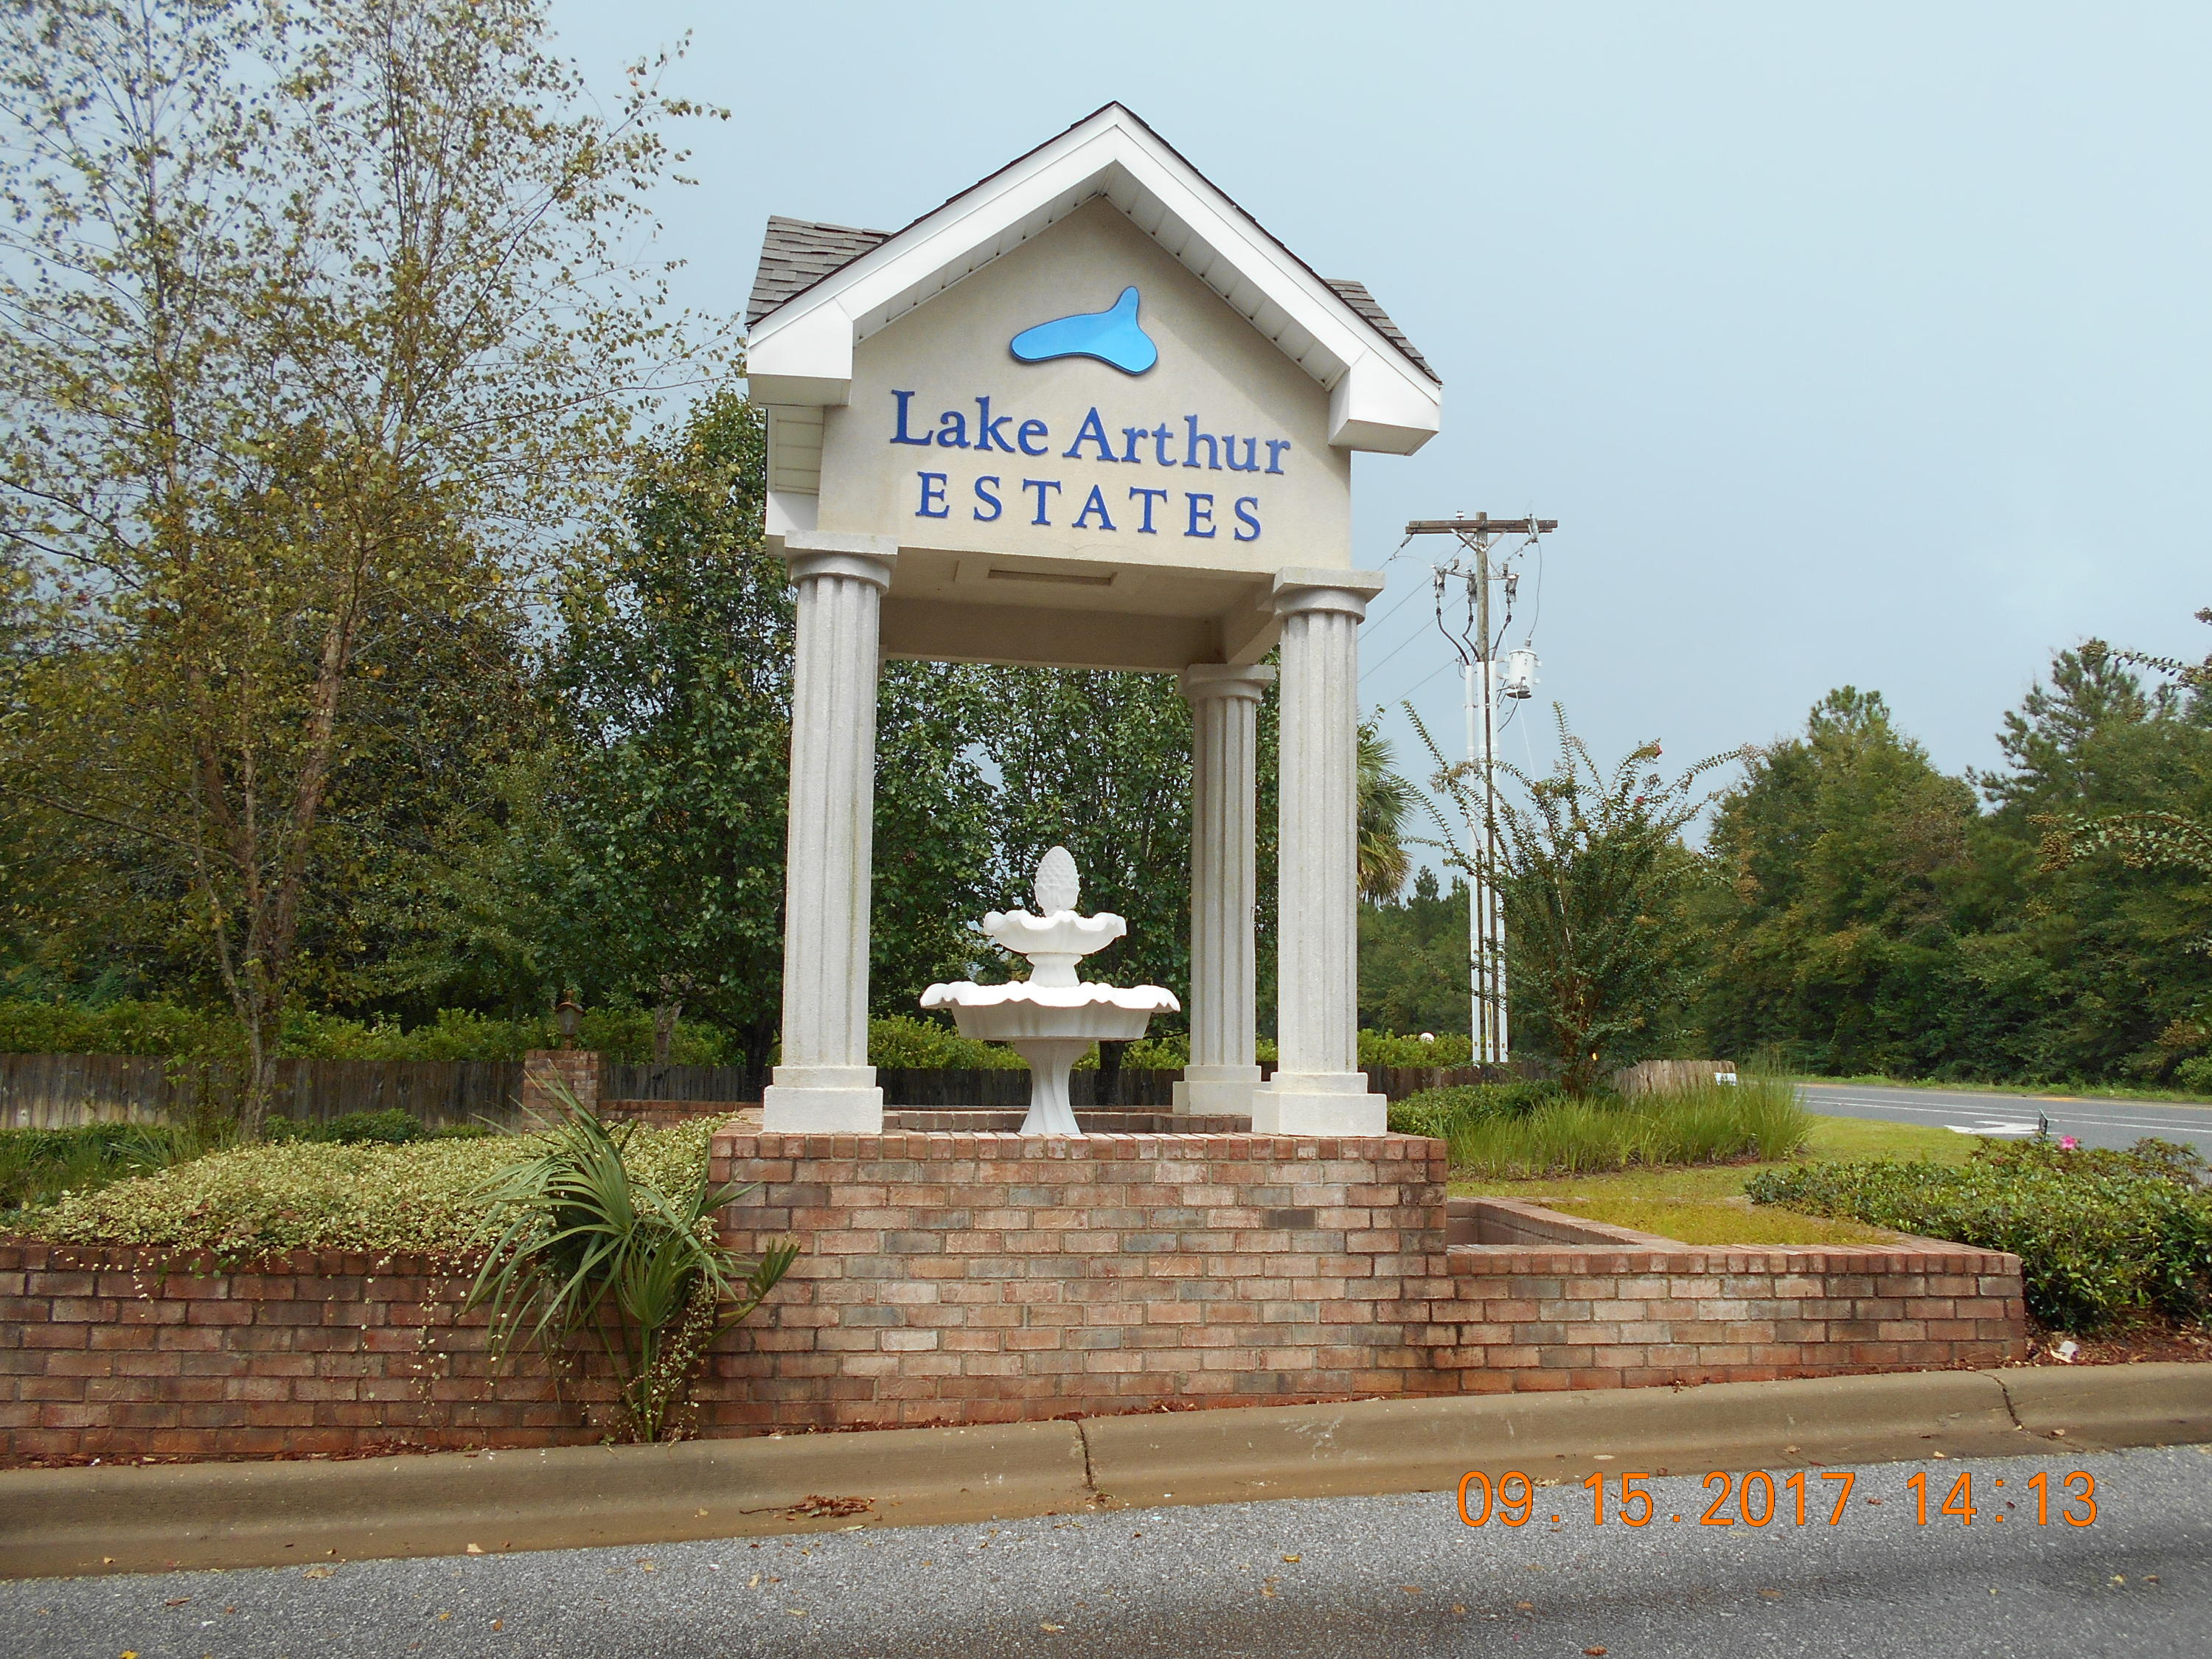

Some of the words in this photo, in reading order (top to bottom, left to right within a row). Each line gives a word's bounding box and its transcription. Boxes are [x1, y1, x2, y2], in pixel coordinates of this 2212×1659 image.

[890, 389, 1049, 456] Lake
[1062, 406, 1291, 475] Arthur
[915, 471, 1262, 542] ESTATES
